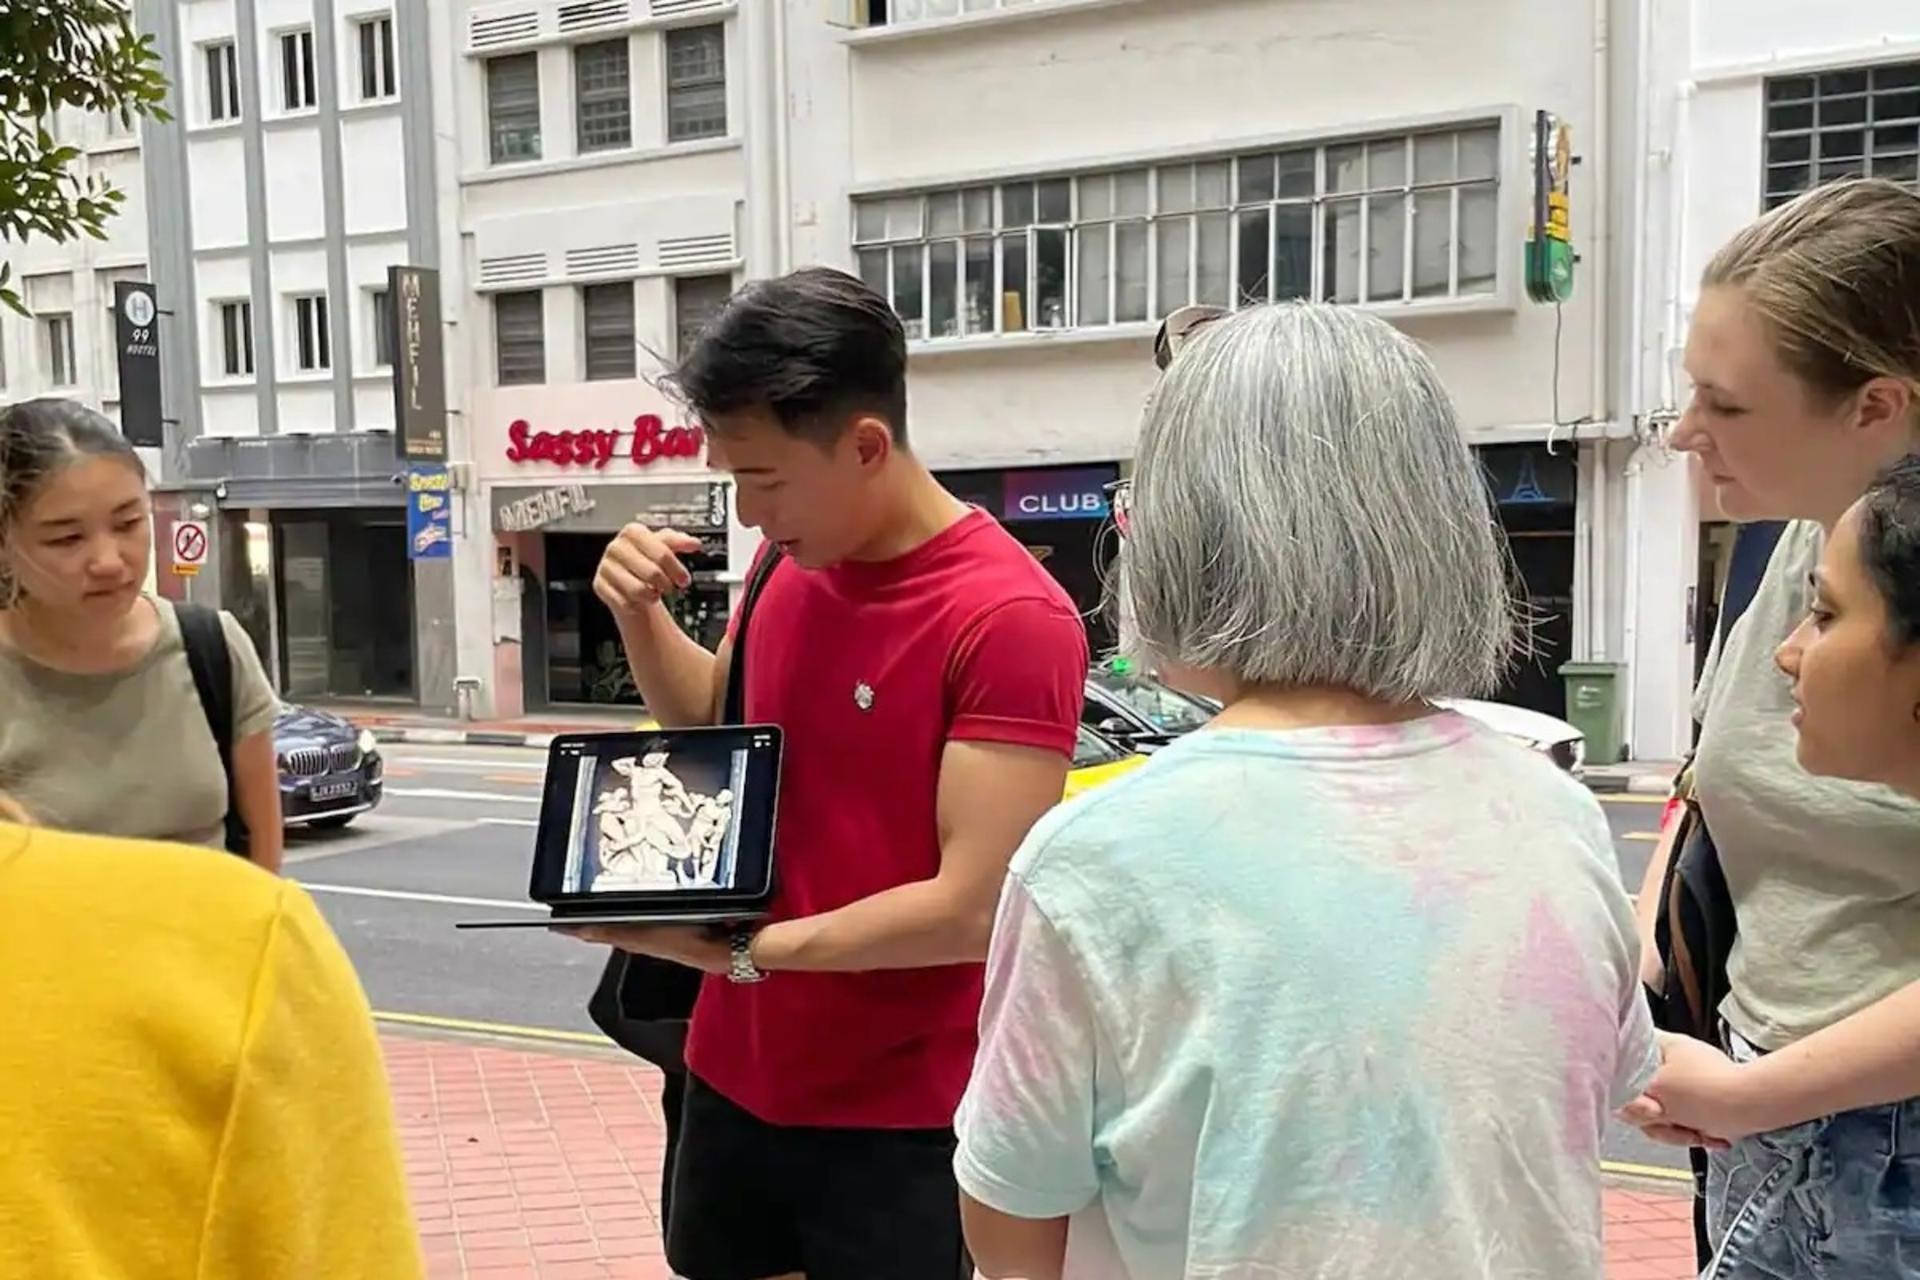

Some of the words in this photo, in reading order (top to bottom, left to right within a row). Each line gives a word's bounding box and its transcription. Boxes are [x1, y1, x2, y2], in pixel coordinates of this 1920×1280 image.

[133, 329, 149, 343] 99
[402, 273, 422, 410] MEHFIL
[506, 419, 621, 469] Sassy
[632, 414, 704, 465] Bar
[499, 483, 596, 531] MEHFIL
[1019, 493, 1099, 512] CLUB
